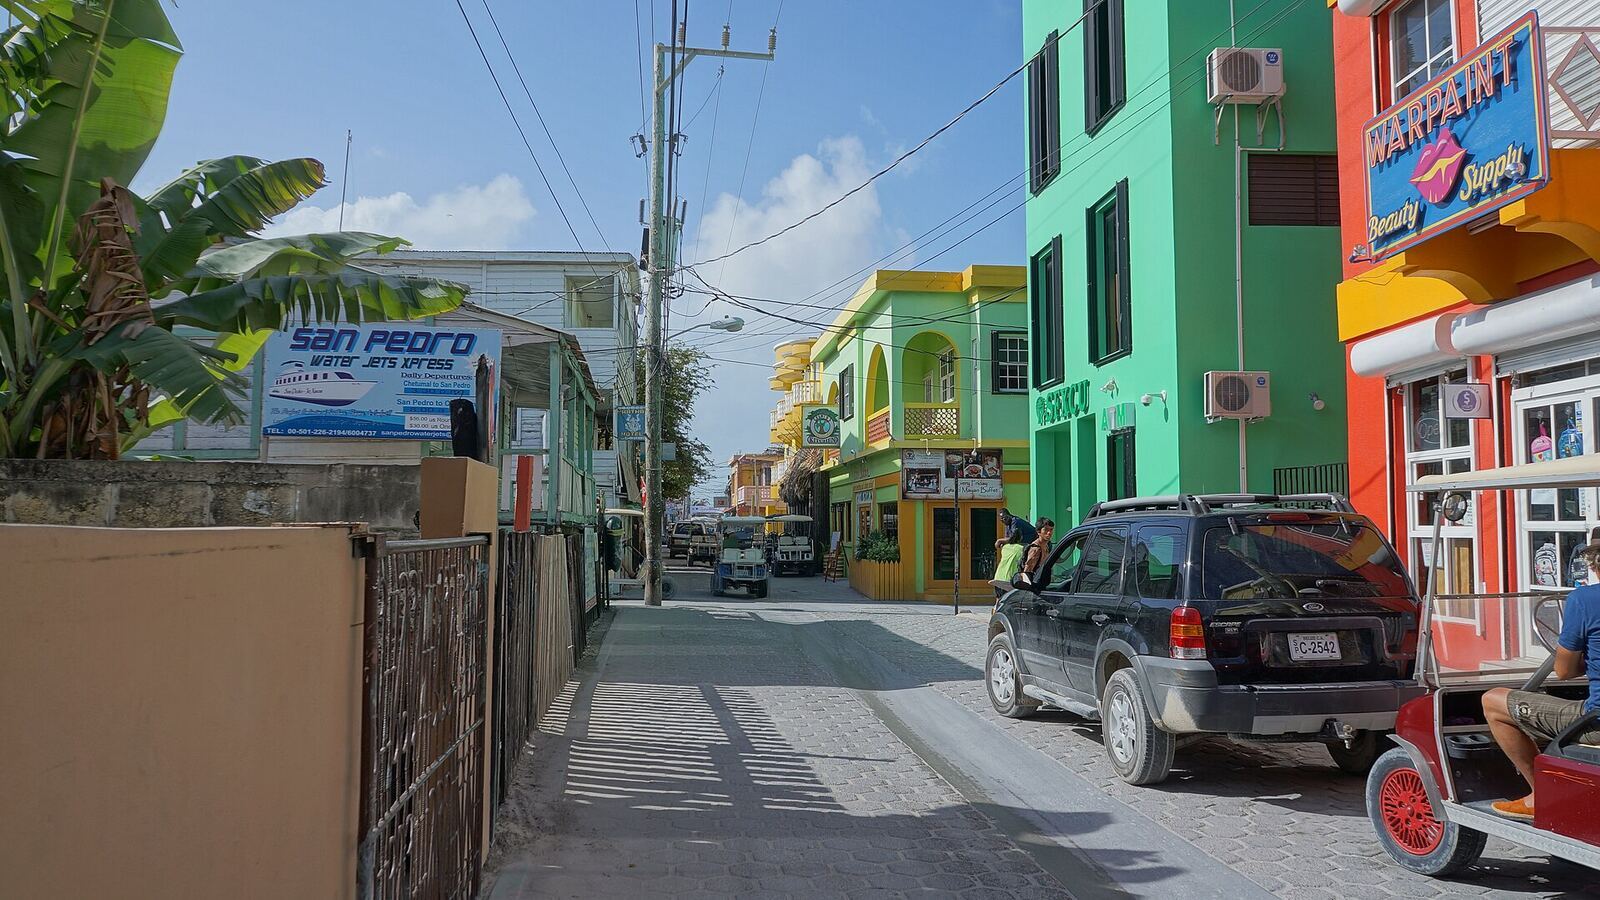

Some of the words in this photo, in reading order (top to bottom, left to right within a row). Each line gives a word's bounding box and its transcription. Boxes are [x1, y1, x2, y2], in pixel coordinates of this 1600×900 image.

[1367, 35, 1516, 167] WARPAINT
[1460, 143, 1524, 200] Supply
[1368, 199, 1420, 241] Beauty
[401, 371, 423, 380] Daily
[403, 380, 432, 388] Chetumal
[440, 381, 451, 389] San
[453, 381, 471, 389] Pedro
[396, 398, 411, 406] San
[412, 399, 434, 407] Pedro
[435, 399, 443, 407] to
[1101, 403, 1127, 431] ATM
[1299, 641, 1337, 654] C-2542
